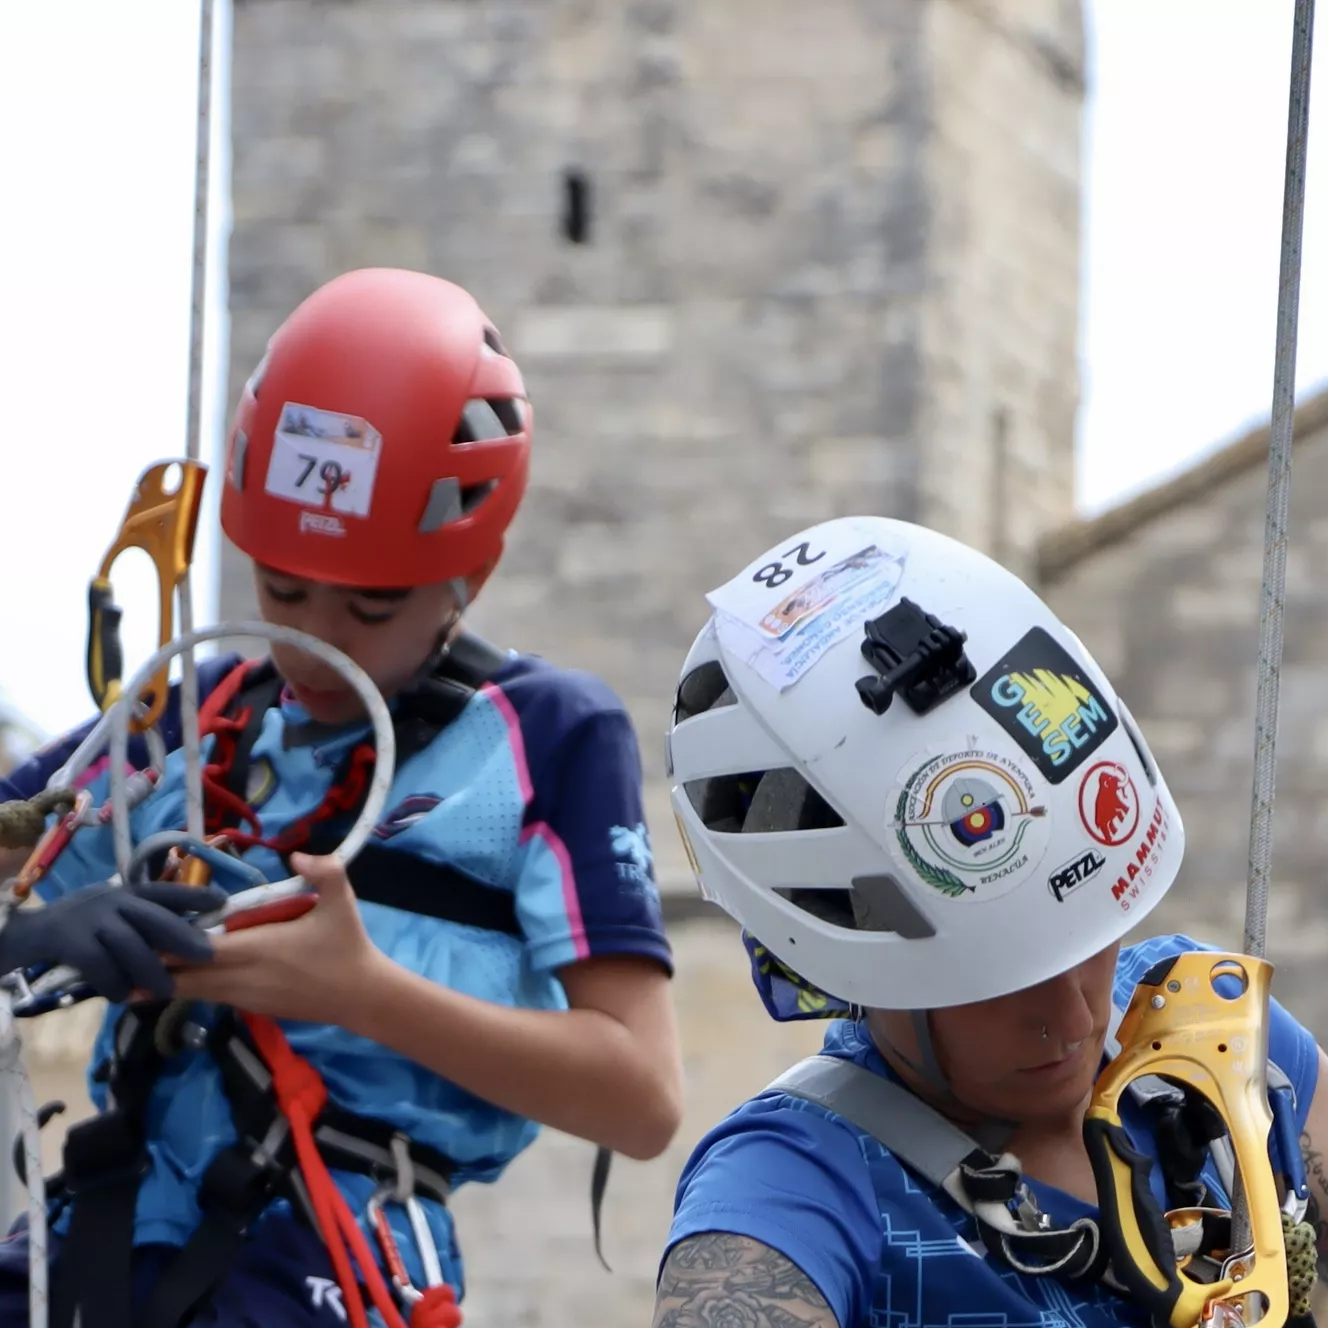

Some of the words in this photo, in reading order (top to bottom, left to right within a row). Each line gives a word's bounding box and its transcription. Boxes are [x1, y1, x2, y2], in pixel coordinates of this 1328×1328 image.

[294, 454, 343, 494] 79
[752, 541, 827, 589] 28
[1111, 795, 1166, 901] MAMMUT
[1049, 855, 1106, 903] PETZL
